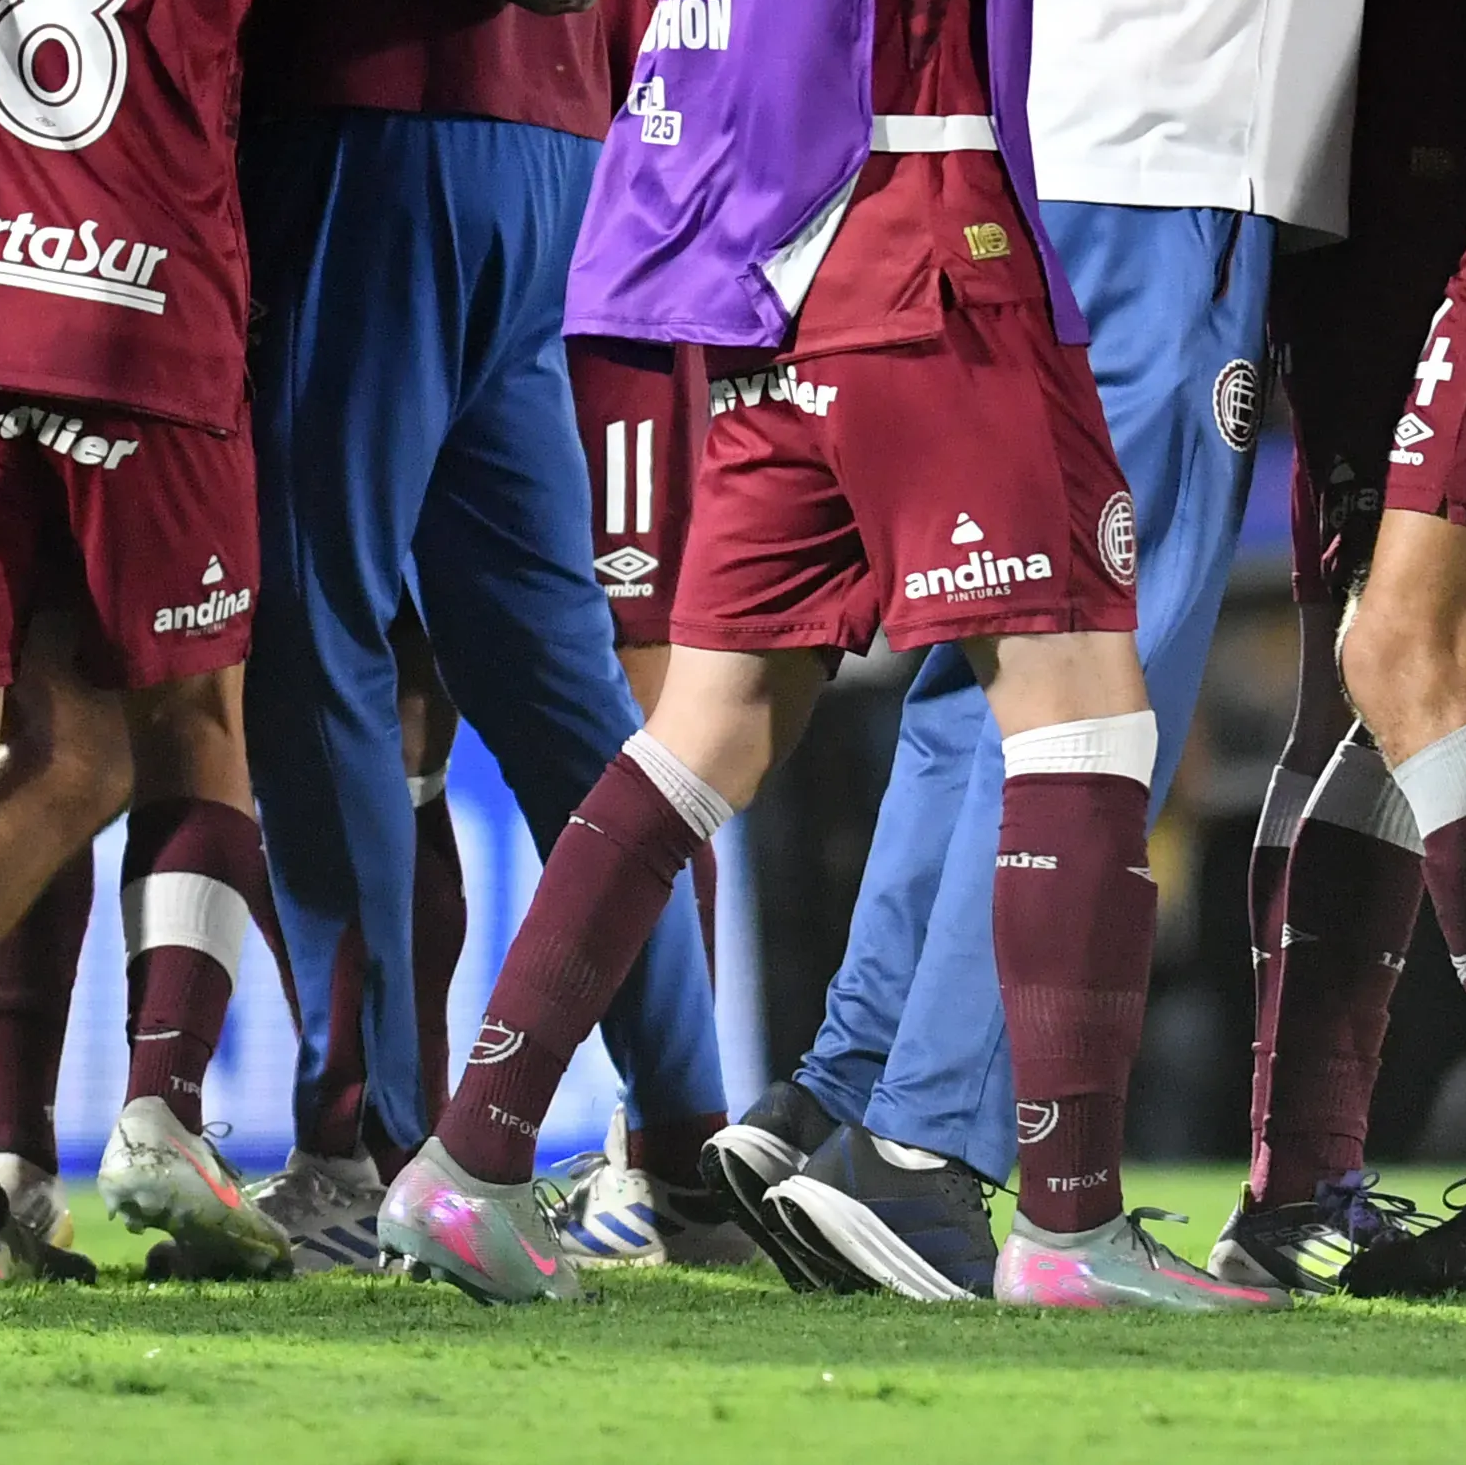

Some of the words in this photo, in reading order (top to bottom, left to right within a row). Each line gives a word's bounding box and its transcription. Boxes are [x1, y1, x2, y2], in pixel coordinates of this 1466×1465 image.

[606, 418, 654, 534] 11
[904, 550, 1053, 600] andina
[946, 584, 1012, 604] PINTURAS
[153, 587, 252, 633] andina
[1046, 1168, 1109, 1193] TIFOX
